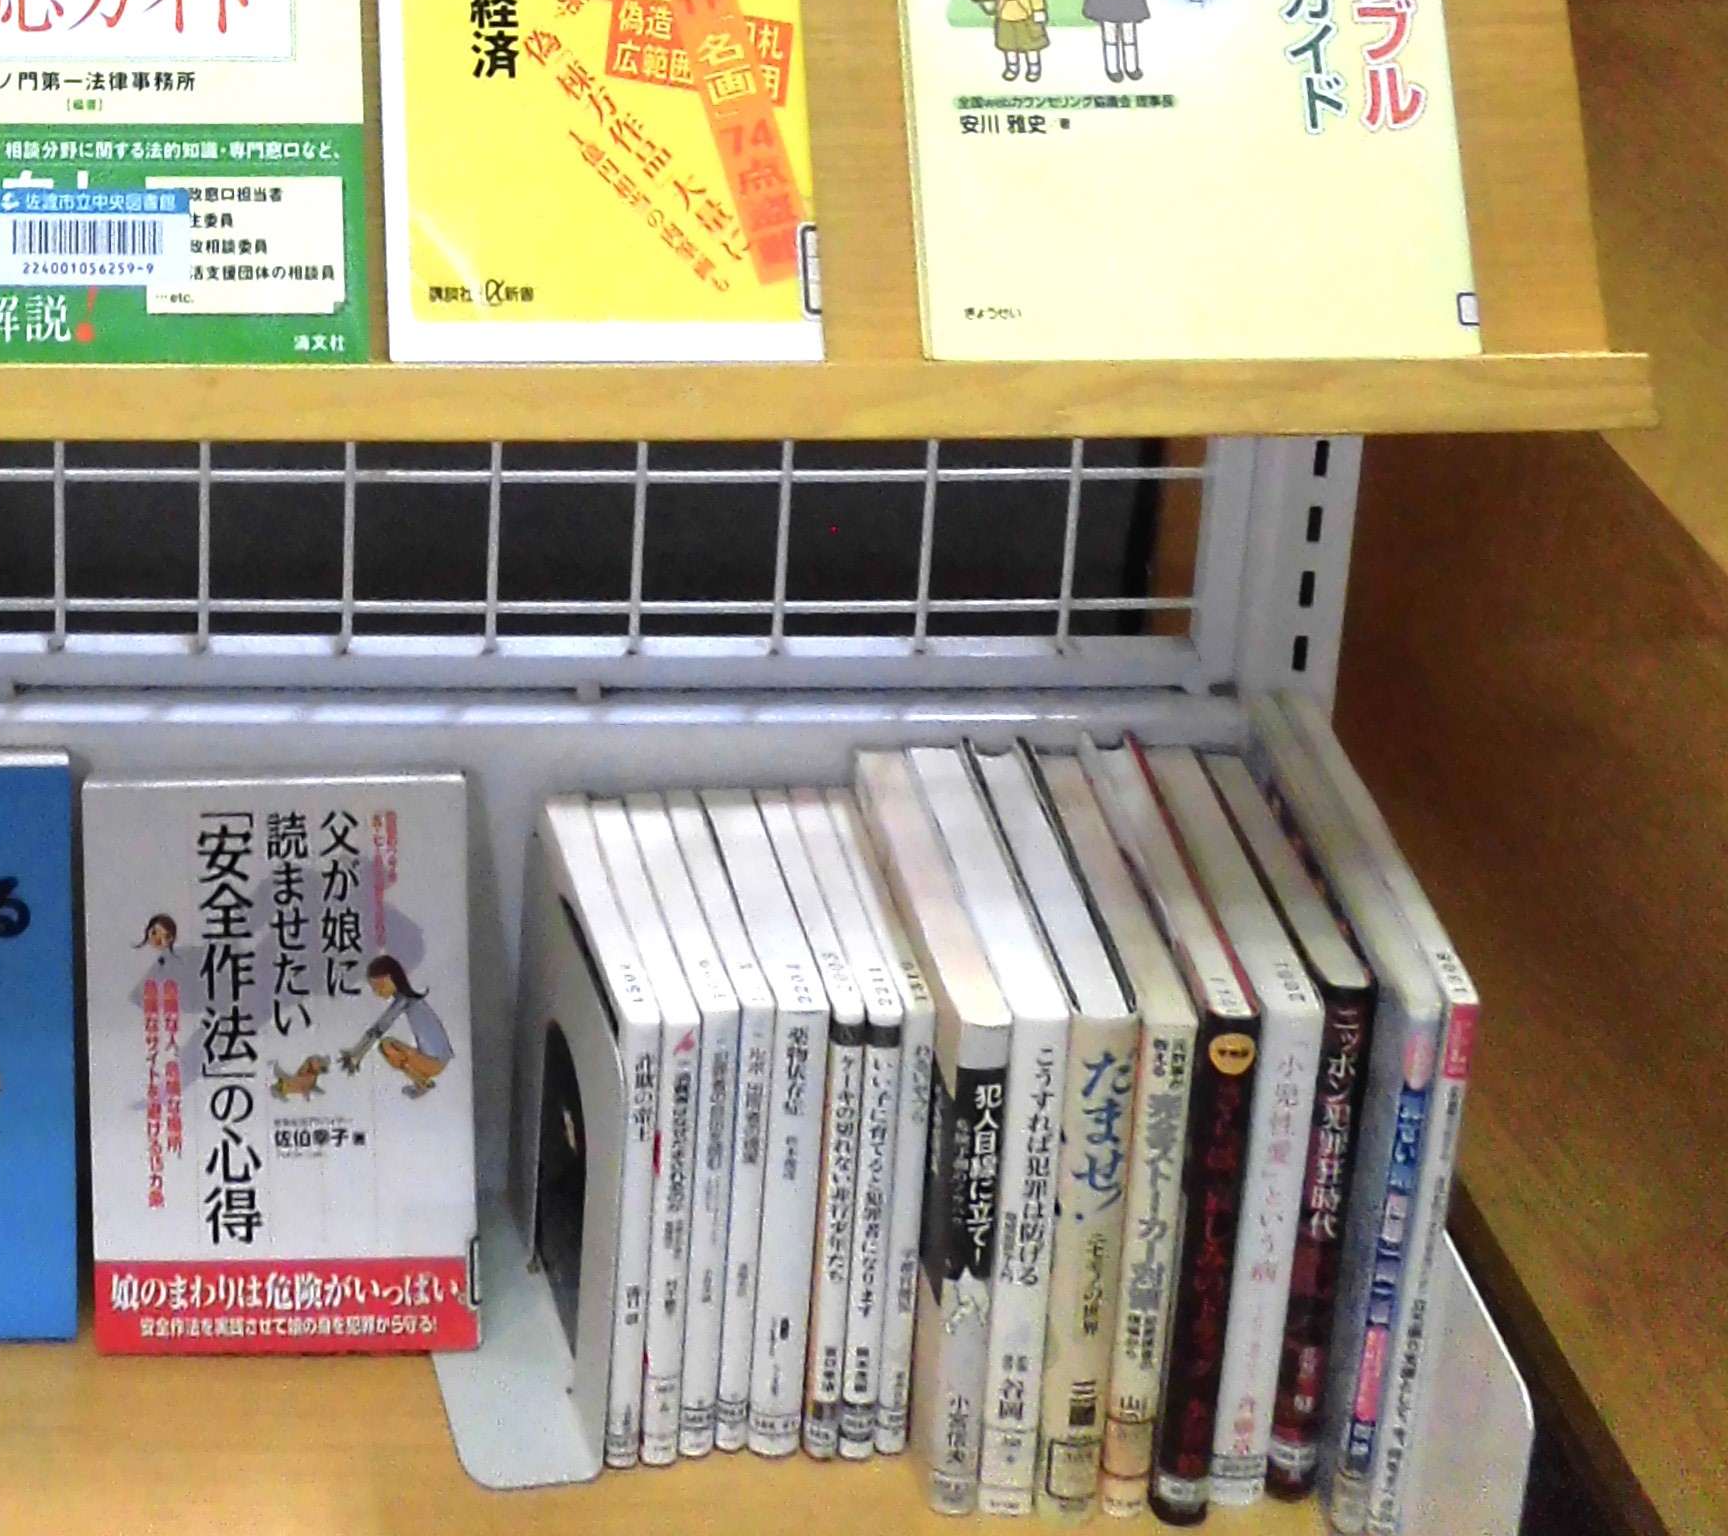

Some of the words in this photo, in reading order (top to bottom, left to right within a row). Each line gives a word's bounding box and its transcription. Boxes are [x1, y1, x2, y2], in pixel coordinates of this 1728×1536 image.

[26, 193, 177, 212] 佐渡市立中央図書館
[959, 114, 1000, 135] 安川
[1008, 114, 1047, 135] 雅史
[266, 812, 311, 1038] 読ませたい
[319, 810, 362, 997] 父が娘に
[196, 811, 263, 1246] 「安全作法」の心得
[1019, 1046, 1055, 1287] こうすれば犯罪は防げる
